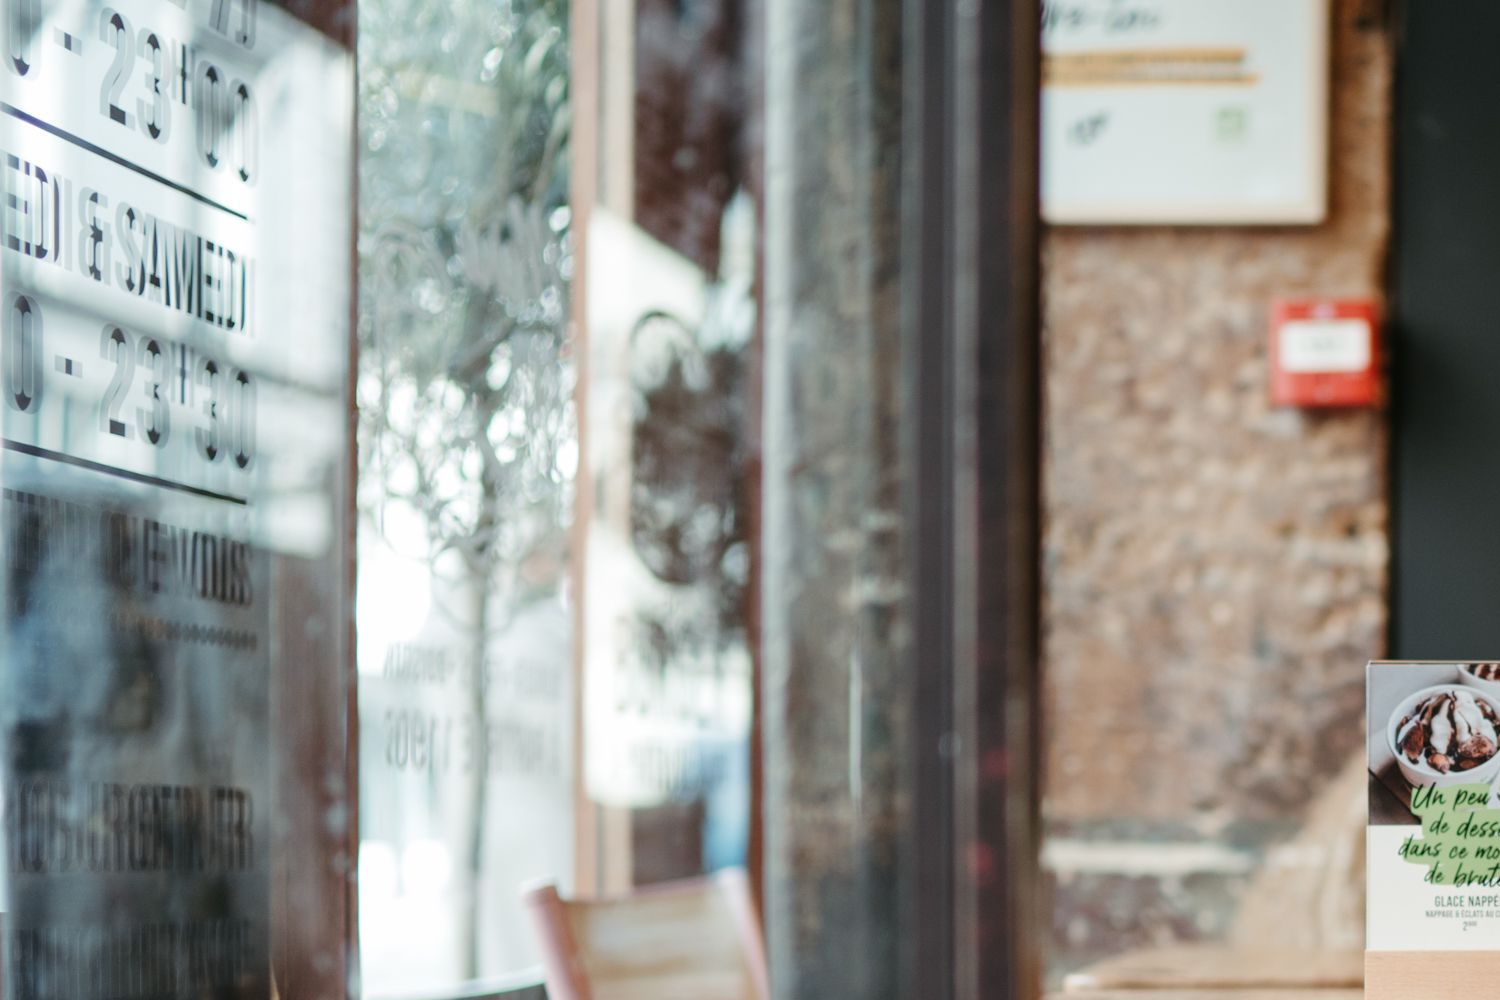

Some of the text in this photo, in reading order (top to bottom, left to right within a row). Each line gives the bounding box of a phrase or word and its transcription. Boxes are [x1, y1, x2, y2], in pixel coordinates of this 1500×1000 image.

[77, 185, 112, 287] &
[115, 200, 256, 337] SAMEDI
[1412, 782, 1490, 811] Un peu
[1429, 812, 1450, 835] de
[1398, 833, 1442, 860] dans
[1448, 845, 1468, 860] ce
[1424, 861, 1444, 884] de
[1434, 895, 1465, 908] GLACE
[1425, 910, 1454, 919] NAPPAGE
[1485, 910, 1494, 919] AU
